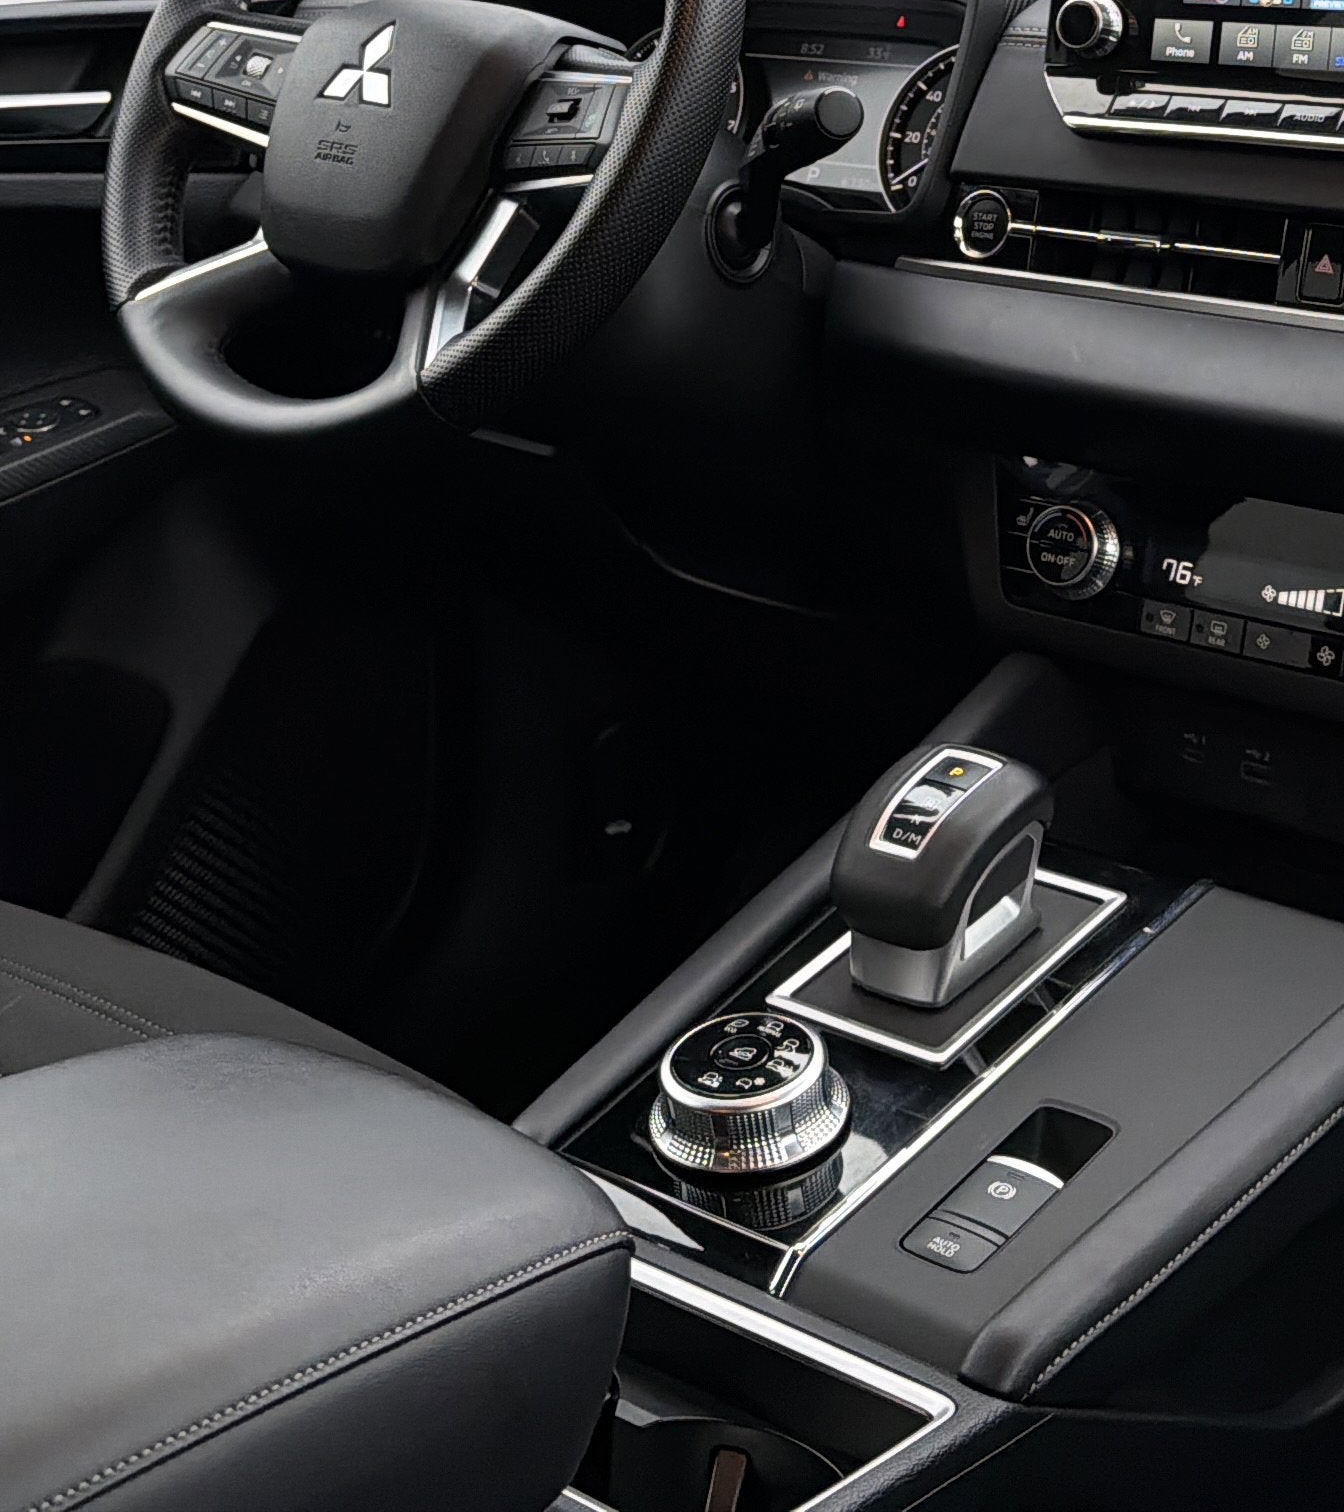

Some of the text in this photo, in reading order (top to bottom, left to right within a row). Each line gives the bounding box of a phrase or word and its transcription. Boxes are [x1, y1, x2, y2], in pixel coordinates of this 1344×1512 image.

[1166, 46, 1195, 58] Phone
[1237, 52, 1254, 61] AM
[1292, 54, 1309, 64] FM
[925, 90, 943, 102] 40
[904, 131, 921, 143] 20
[316, 139, 358, 155] SRS
[314, 152, 354, 165] AIRBAG
[907, 175, 917, 187] 0
[973, 212, 998, 222] START
[973, 221, 994, 230] STOP
[1047, 528, 1075, 542] AUTO
[949, 767, 964, 776] P
[892, 828, 922, 846] D/M
[927, 1242, 954, 1258] HOLD
[933, 1237, 960, 1252] AUTO
